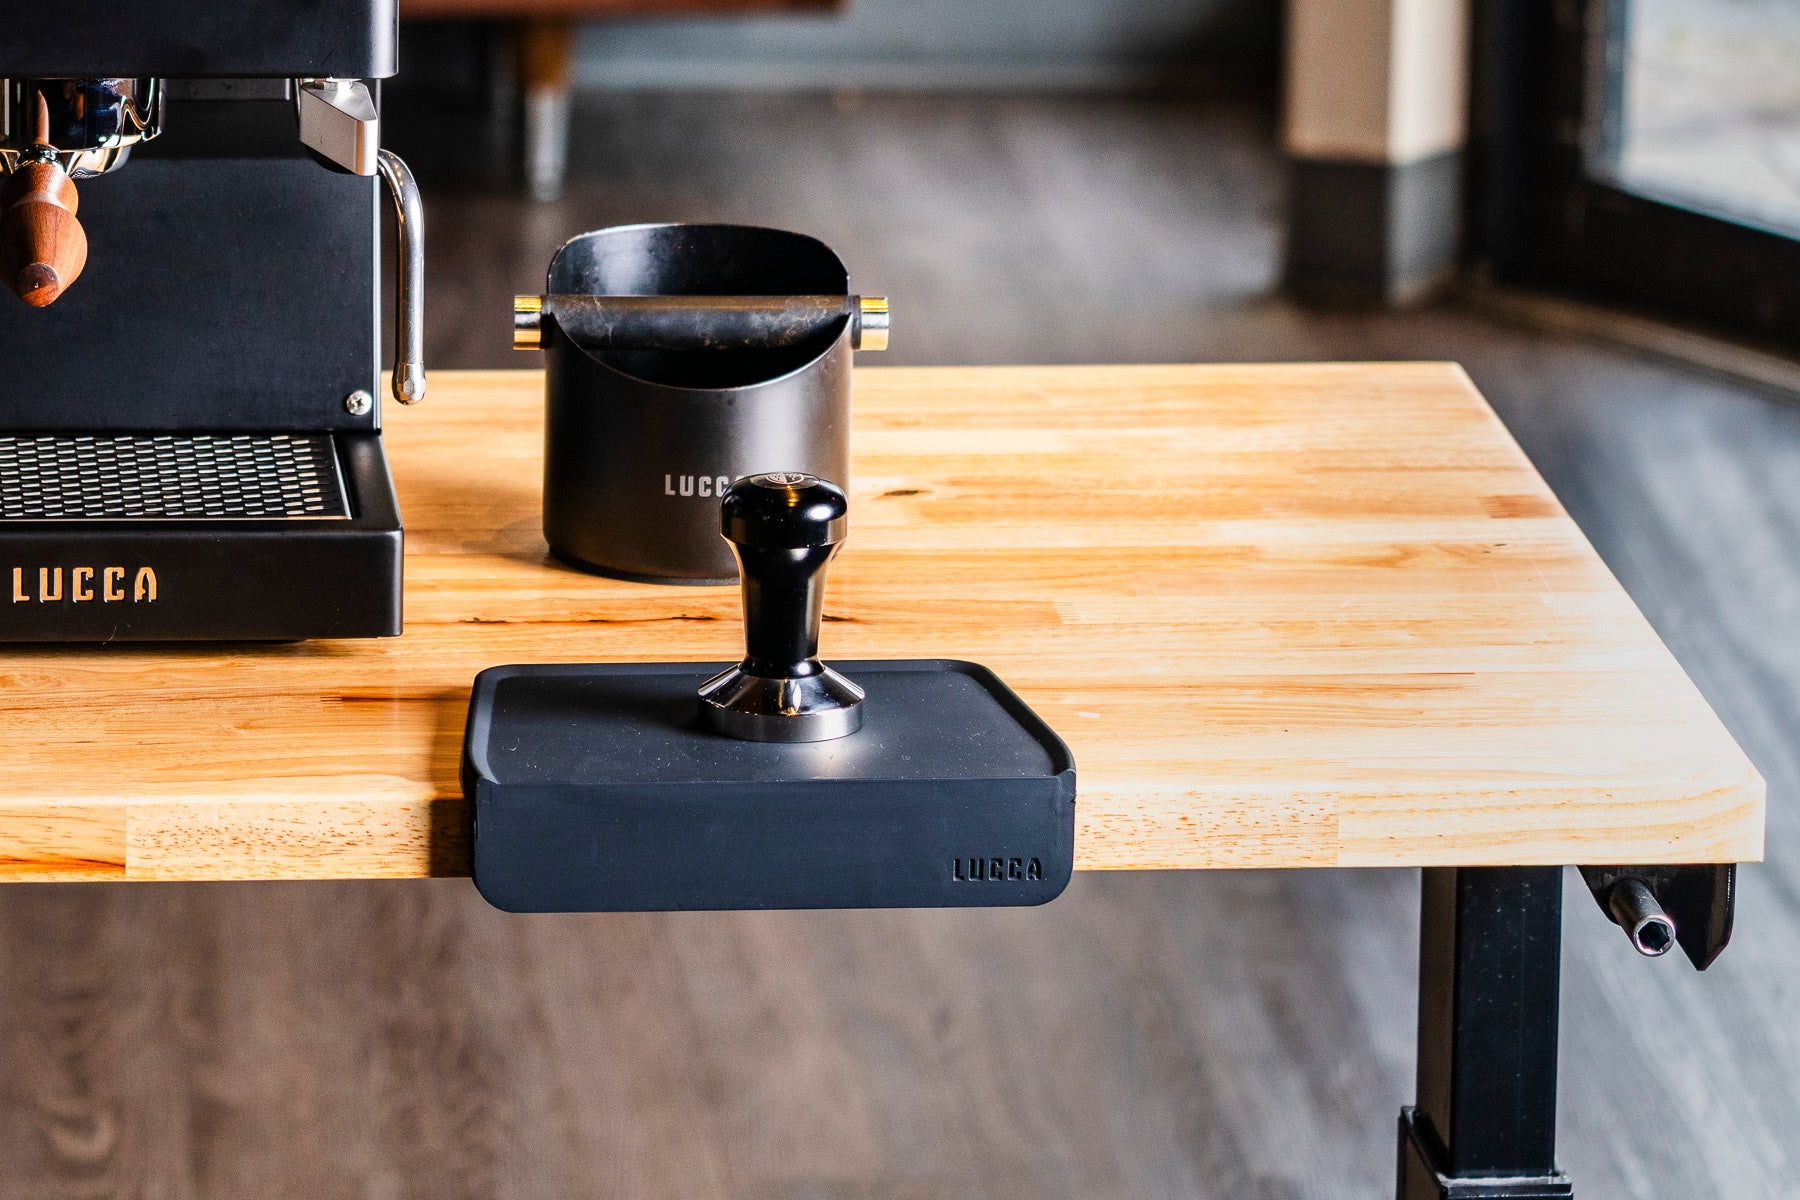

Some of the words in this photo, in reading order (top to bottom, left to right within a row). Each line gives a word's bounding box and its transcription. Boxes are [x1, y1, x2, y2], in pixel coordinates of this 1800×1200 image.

[664, 474, 744, 498] LUCC
[13, 567, 157, 603] LUCCA
[953, 857, 1042, 881] LUCCA
